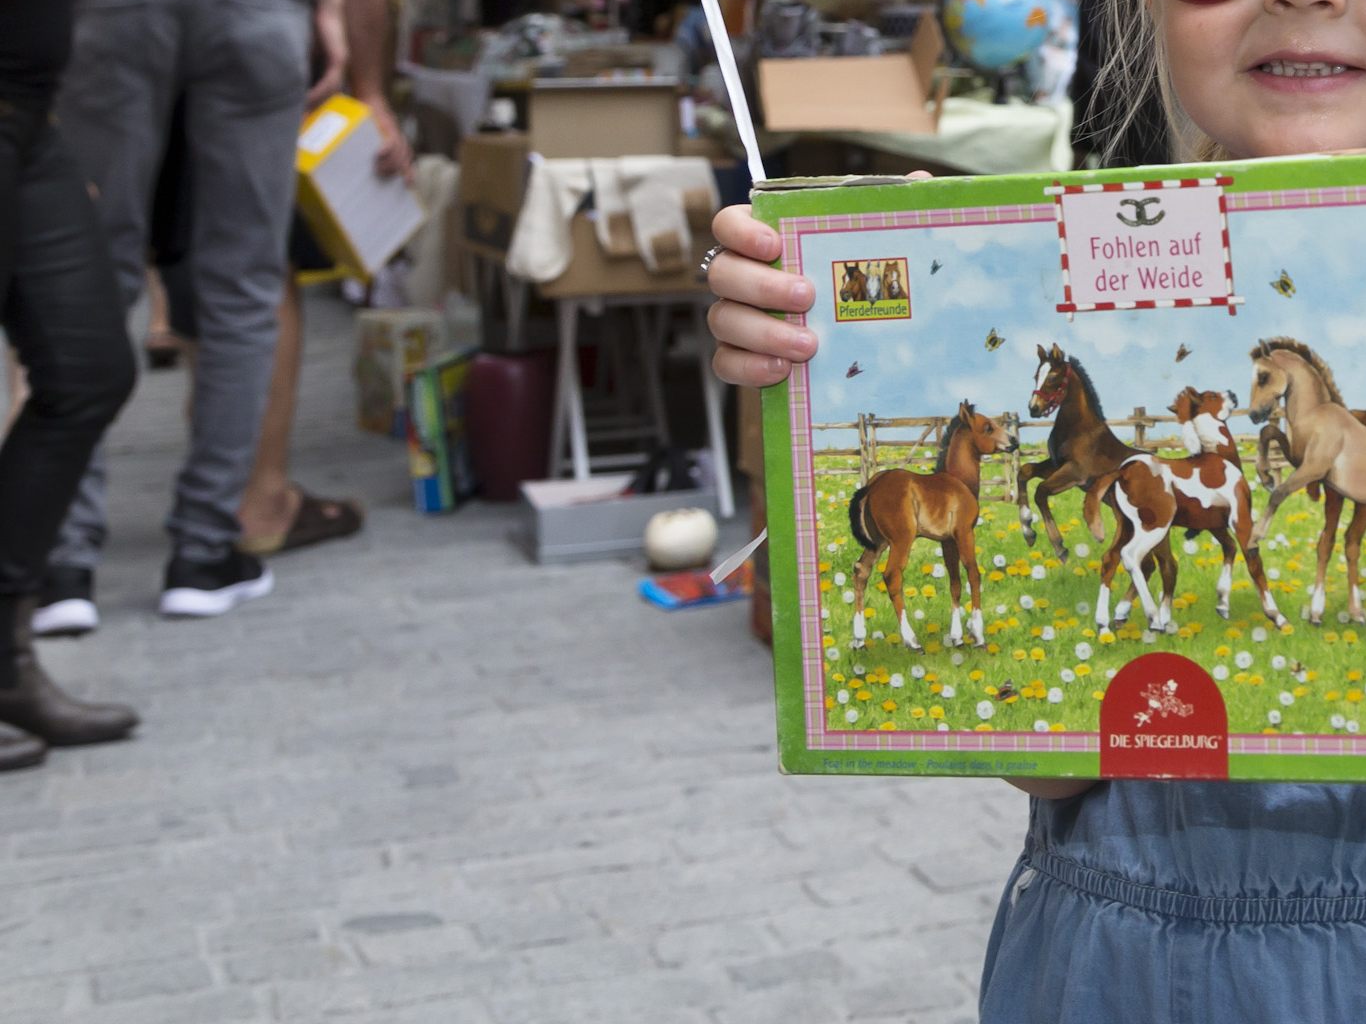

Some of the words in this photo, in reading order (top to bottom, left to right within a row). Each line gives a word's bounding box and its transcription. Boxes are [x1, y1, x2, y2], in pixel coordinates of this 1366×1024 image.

[1090, 235, 1160, 260] Fohlen
[1169, 232, 1202, 256] auf
[1095, 269, 1129, 292] der
[1137, 265, 1204, 290] Weide
[840, 304, 907, 317] Pferdefreunde
[1110, 734, 1132, 749] DIE
[1134, 734, 1219, 750] SPIEGELBURG
